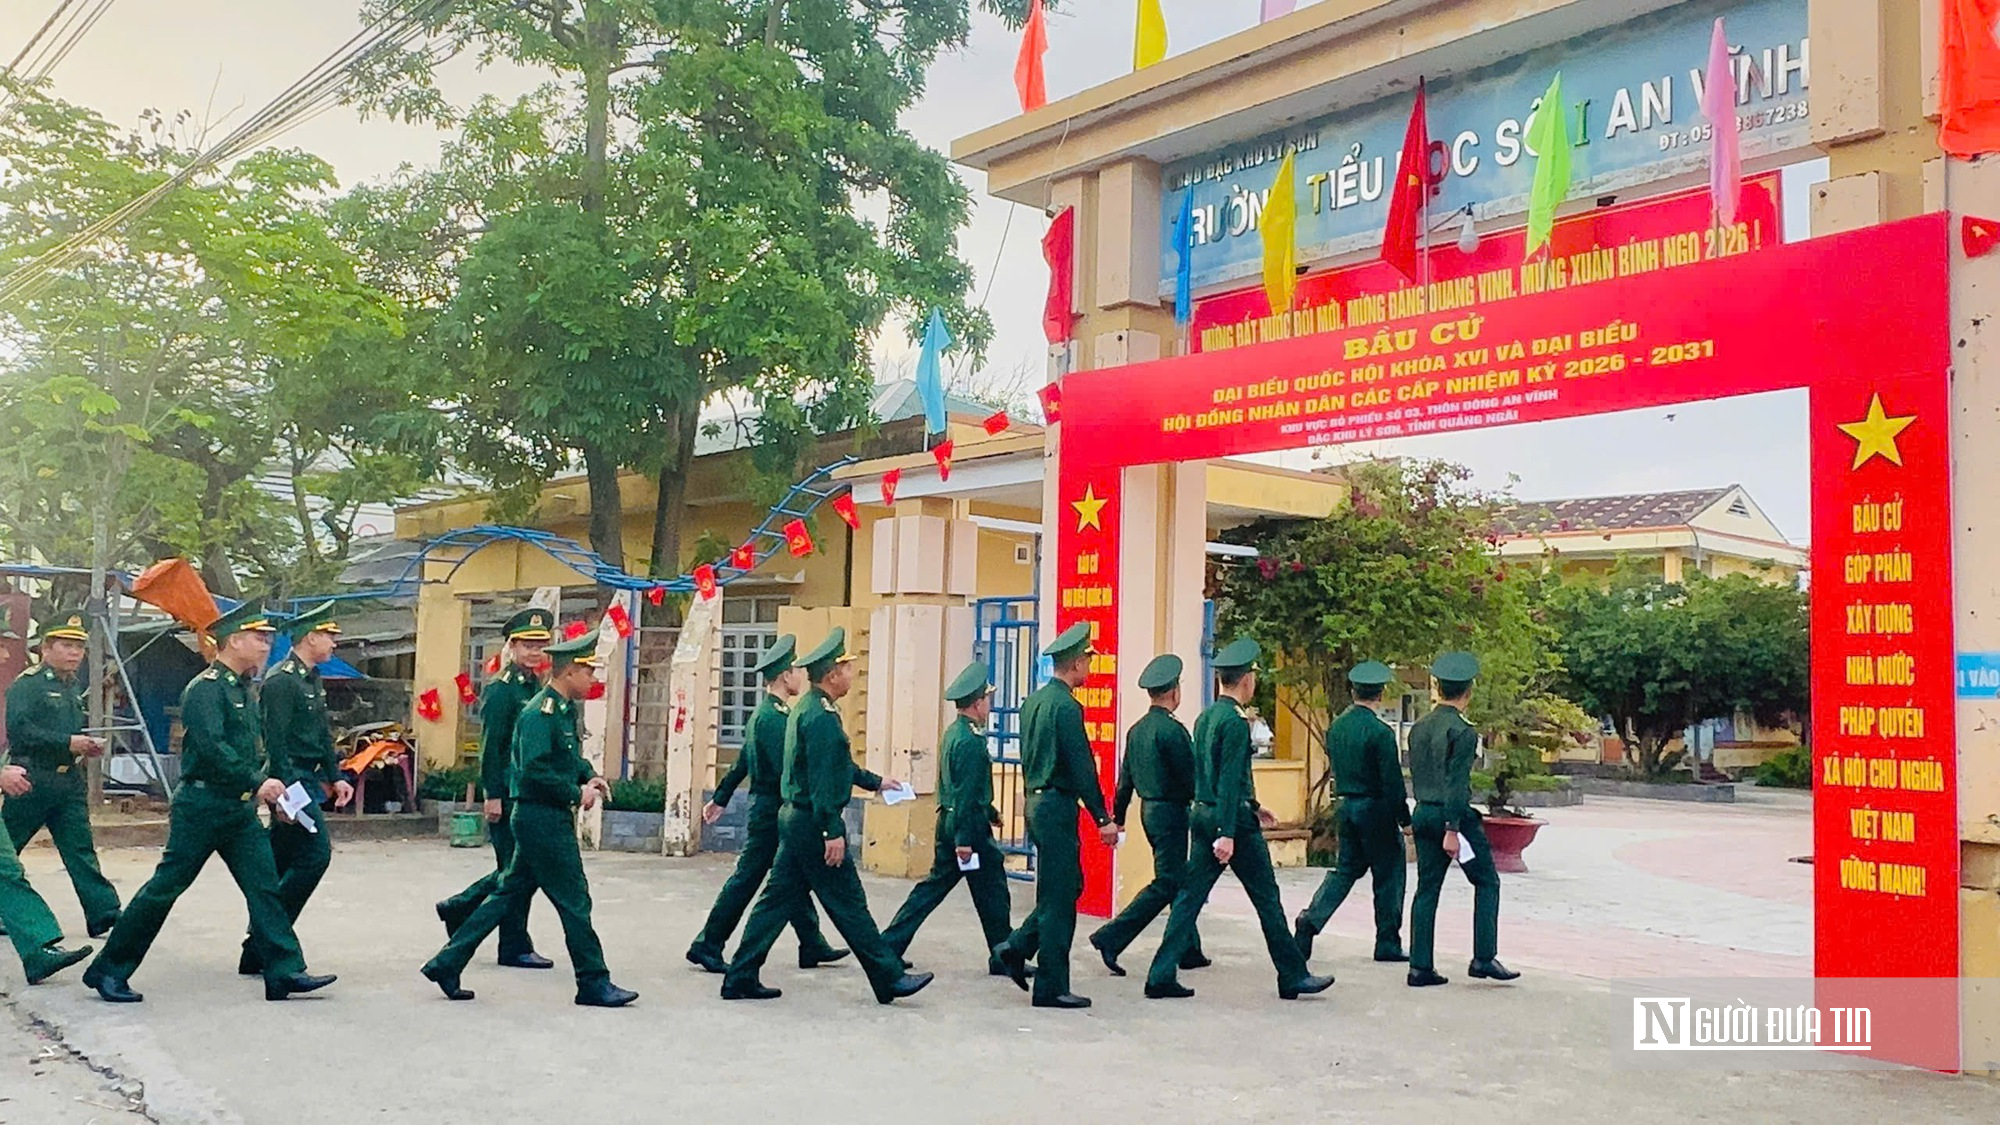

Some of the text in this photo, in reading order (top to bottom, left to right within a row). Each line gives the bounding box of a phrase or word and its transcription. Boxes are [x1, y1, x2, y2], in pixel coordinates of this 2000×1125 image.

[1171, 183, 1270, 247] RƯỜN
[1306, 142, 1384, 214] TIỂU
[1396, 130, 1480, 196] ỌC
[1605, 75, 1673, 139] AN
[1236, 149, 1264, 171] KHU
[1236, 309, 1257, 347] ĐẤT
[1520, 254, 1567, 296] MỪNG
[1571, 243, 1615, 286] XUÂN
[1618, 236, 1659, 277] BÍNH
[1343, 312, 1485, 360] BẦU CỬ
[1213, 319, 1639, 404] ĐẠI BIỂU QUỐC HỘI KHÓA XVI VÀ ĐẠI BIỂU
[1163, 416, 1192, 433] HỘI
[1196, 407, 1244, 427] ĐỒNG
[1248, 399, 1300, 422] NHÂN
[1305, 394, 1345, 414] DÂN
[1351, 388, 1392, 408] CÁC
[1397, 377, 1440, 402] CẤP
[1446, 370, 1521, 395] NHIỆM
[1526, 360, 1557, 384] KỲ
[1564, 354, 1625, 379] 2026
[1651, 339, 1715, 366] 2031
[1280, 422, 1303, 434] KHU
[1427, 401, 1460, 416] THÔN
[1502, 394, 1522, 406] AN
[1525, 389, 1559, 403] VĨNH
[1332, 430, 1357, 442] KHU
[1359, 426, 1374, 439] LÝ
[1853, 491, 1904, 534] BẦU CỬ
[1845, 544, 1913, 584] GÓP PHẦN
[1846, 599, 1914, 641] XÂY DỰNG
[1846, 650, 1915, 686] NHÀ NƯỚC
[1840, 698, 1925, 740] PHÁP QUYỀN
[1823, 749, 1945, 793] XÃ HỘI CHỦ NGHĨA
[1850, 804, 1915, 846] VIỆT NAM
[1840, 854, 1927, 901] VỮNG MẠNH!
